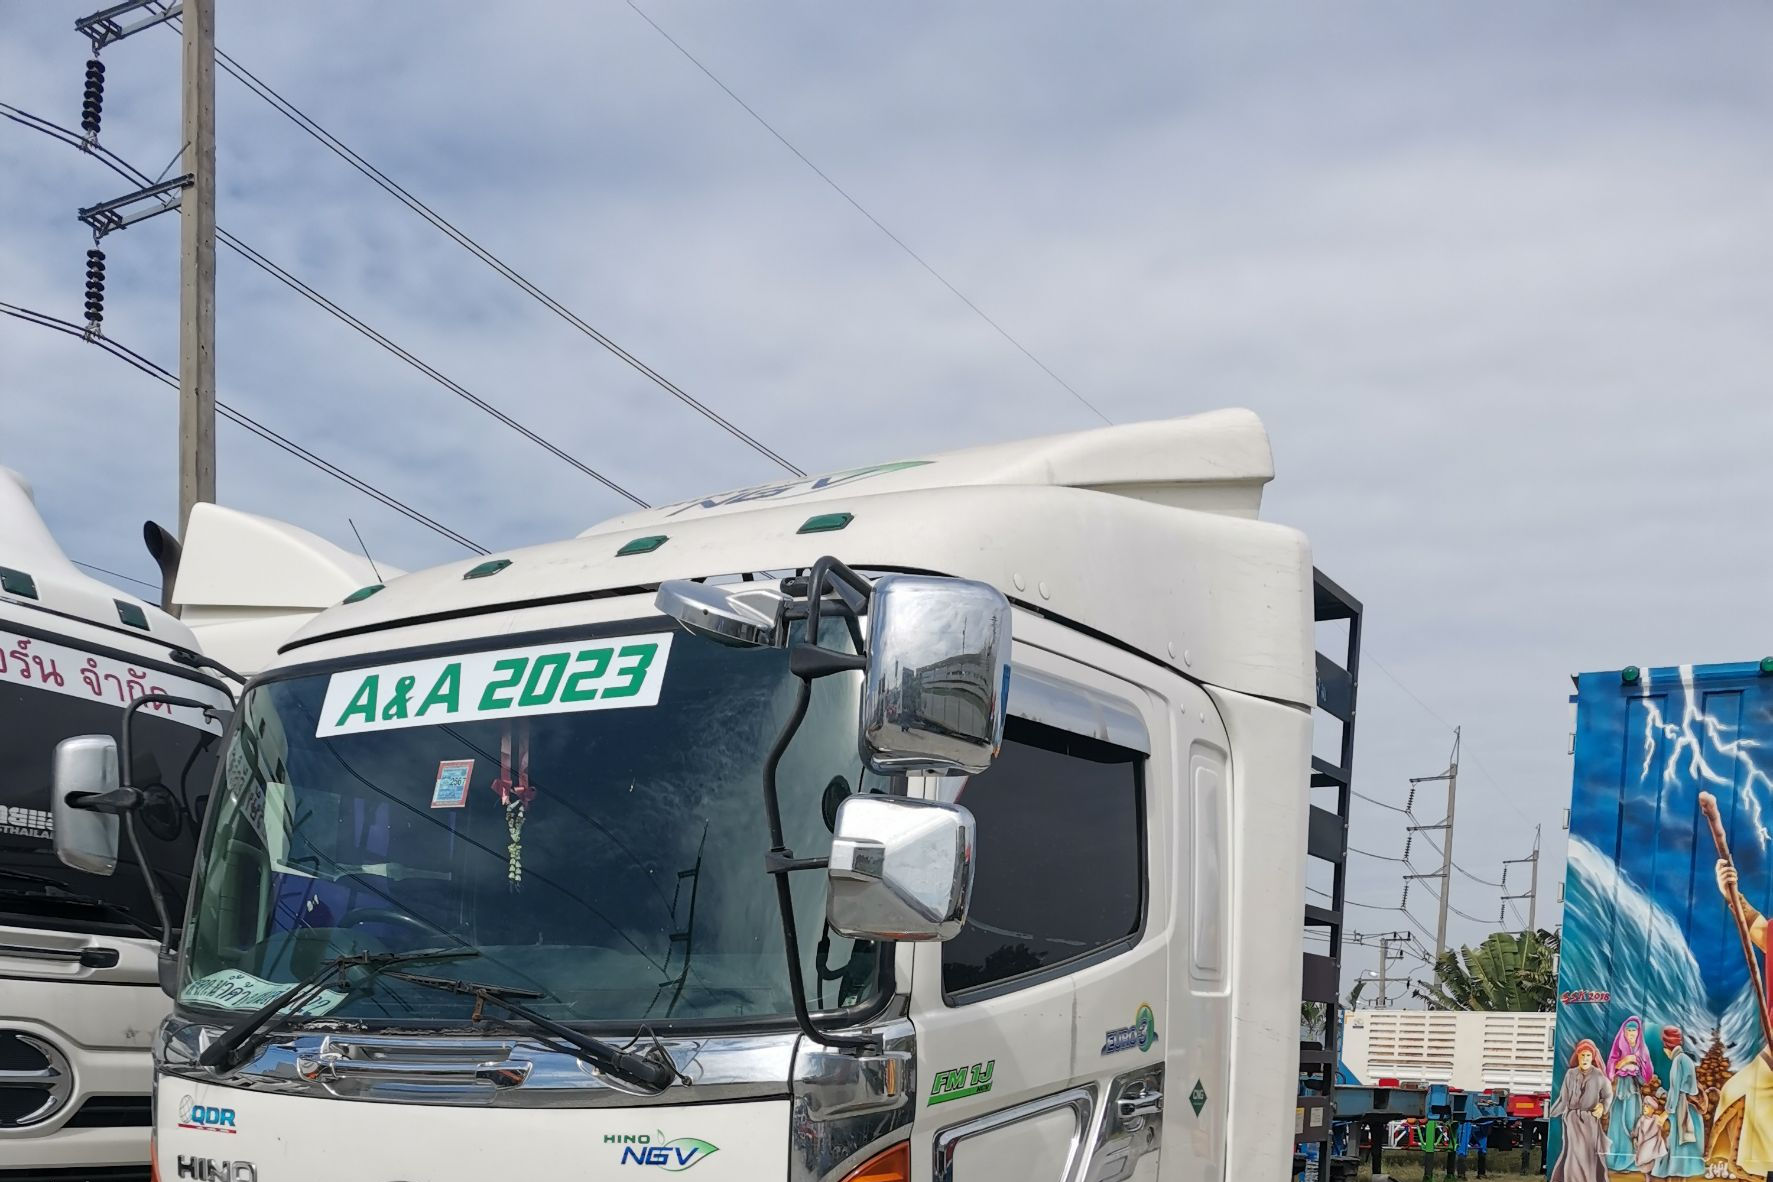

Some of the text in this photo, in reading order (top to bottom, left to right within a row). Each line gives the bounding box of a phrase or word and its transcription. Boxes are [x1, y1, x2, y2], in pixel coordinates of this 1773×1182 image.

[80, 657, 172, 714] จำกัด
[335, 643, 658, 727] A&A 2023
[931, 1060, 995, 1095] FM 1J
[191, 1105, 236, 1127] QDR
[604, 1134, 650, 1144] HINO
[621, 1146, 699, 1165] NGV
